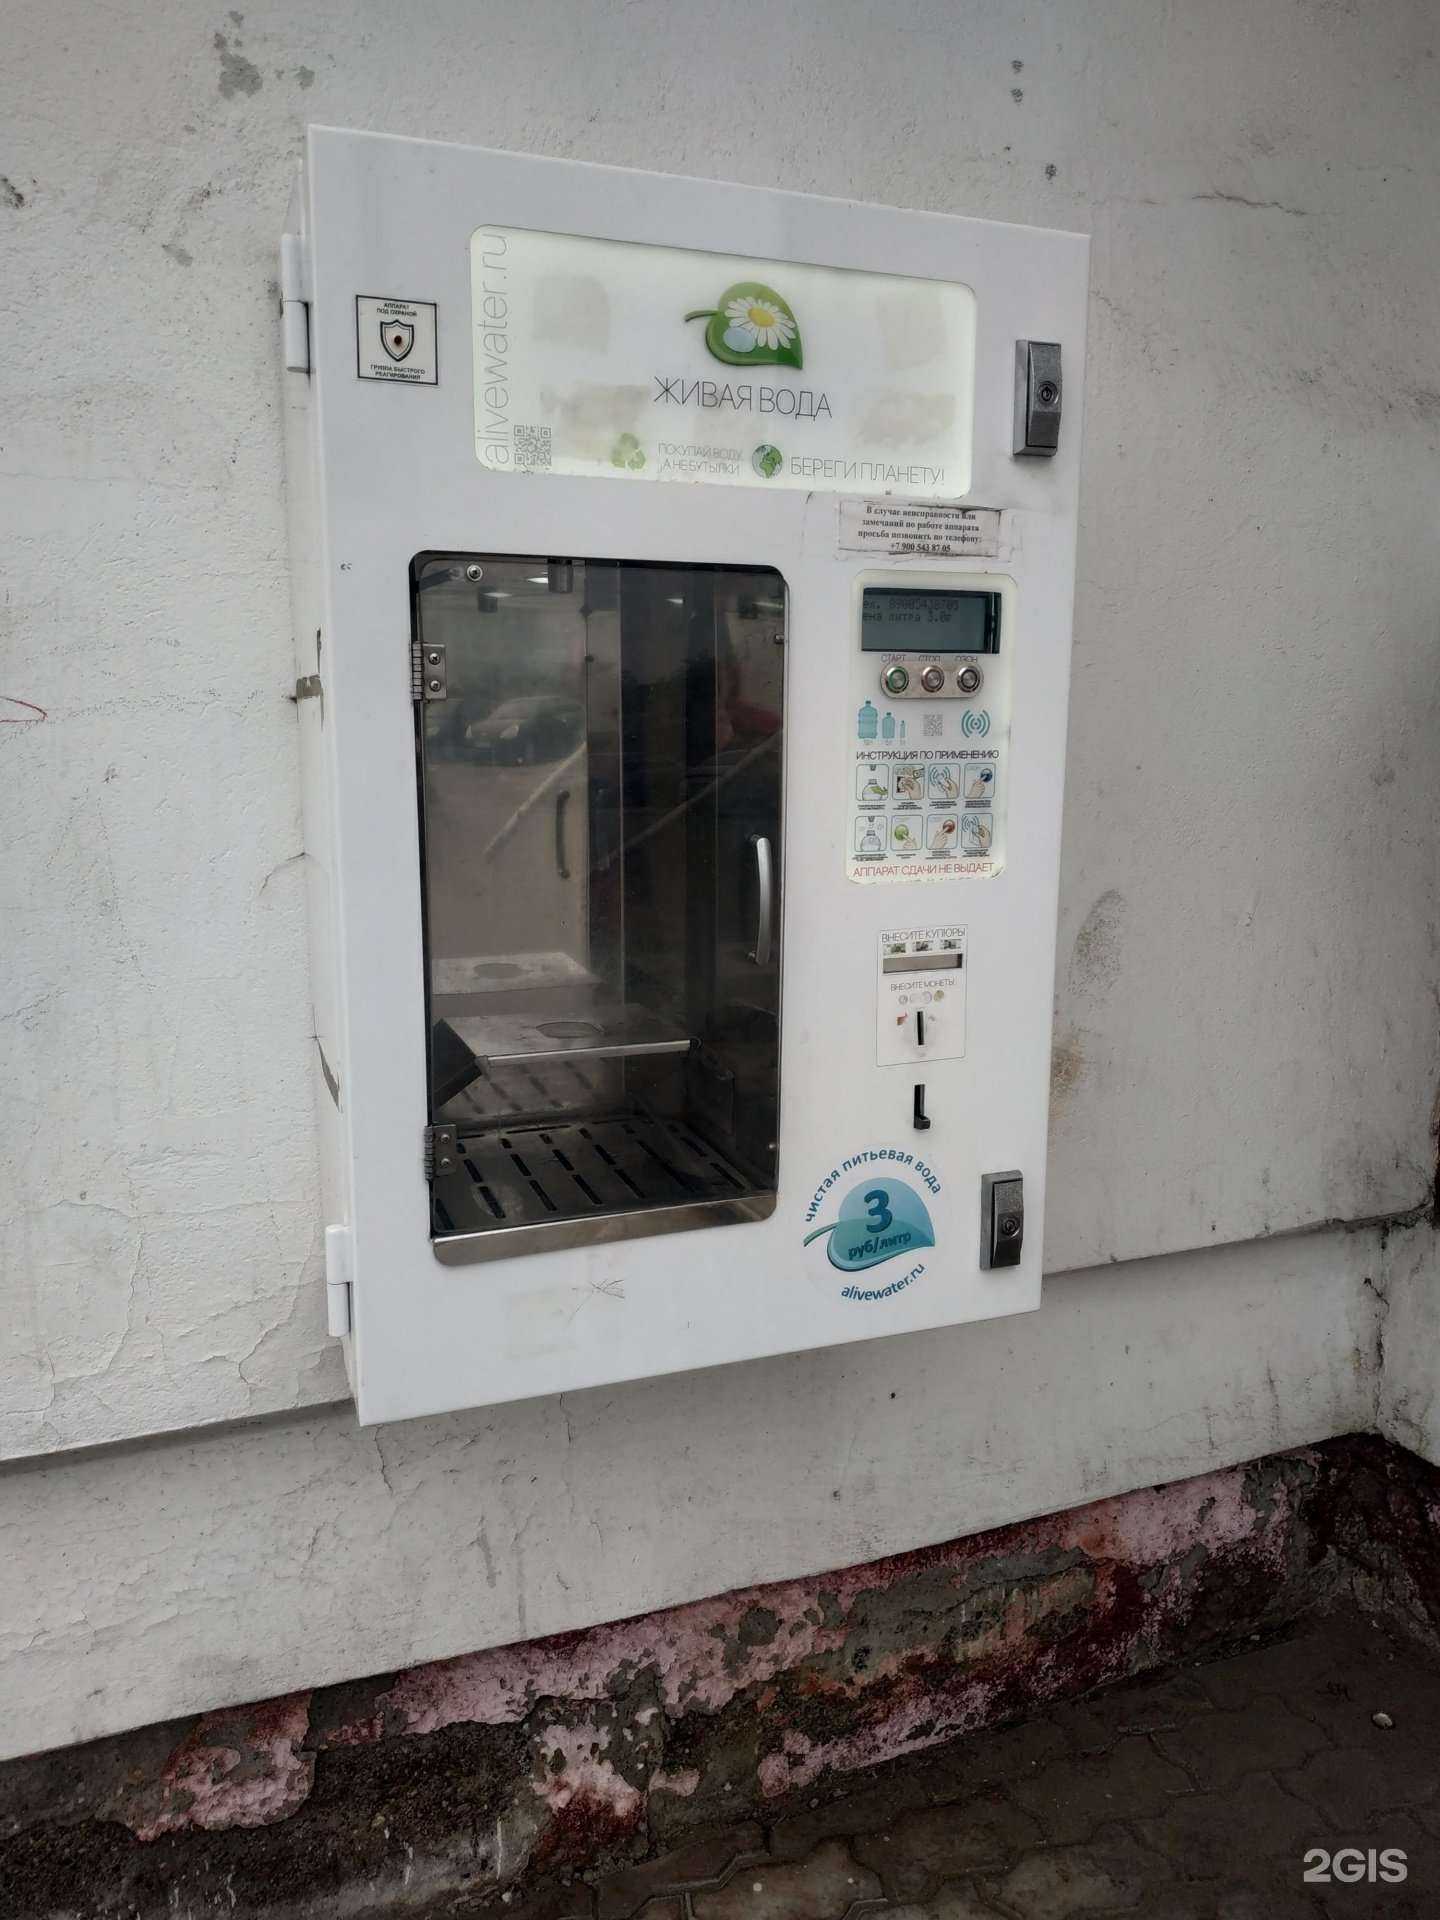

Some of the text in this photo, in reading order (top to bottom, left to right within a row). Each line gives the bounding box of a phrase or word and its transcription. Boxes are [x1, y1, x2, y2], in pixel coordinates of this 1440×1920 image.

[477, 234, 509, 465] alivewater.ru
[653, 376, 833, 421] ЖИВАЯ ВОДА
[790, 457, 945, 485] БЕРЕГИ ПЛАНЕТУ!
[866, 505, 872, 514] В
[874, 507, 901, 517] случае
[902, 509, 960, 520] неисправности
[862, 519, 904, 528] замечаний
[917, 521, 943, 531] работе
[944, 524, 980, 533] аппарата
[857, 529, 889, 539] просьба
[891, 532, 932, 541] позвонить
[890, 542, 951, 552] +7 900 543 87 05
[881, 654, 906, 663] СТАРТ
[856, 750, 999, 761] ИНСТРУКЦИЯ ПО ПРИМЕНЕНИЮ
[853, 862, 994, 877] АППАРАТ СДАЧИ НЕ ВЫДАЕТ
[881, 927, 966, 943] ВНЕСИТЕ КУПЮРЫ
[890, 981, 923, 992] ВНЕСИТЕ
[805, 1149, 942, 1222] чистая питьевая вода
[863, 1189, 893, 1234] 3
[848, 1232, 912, 1261] руб/литр
[841, 1263, 926, 1301] alivewater.ru
